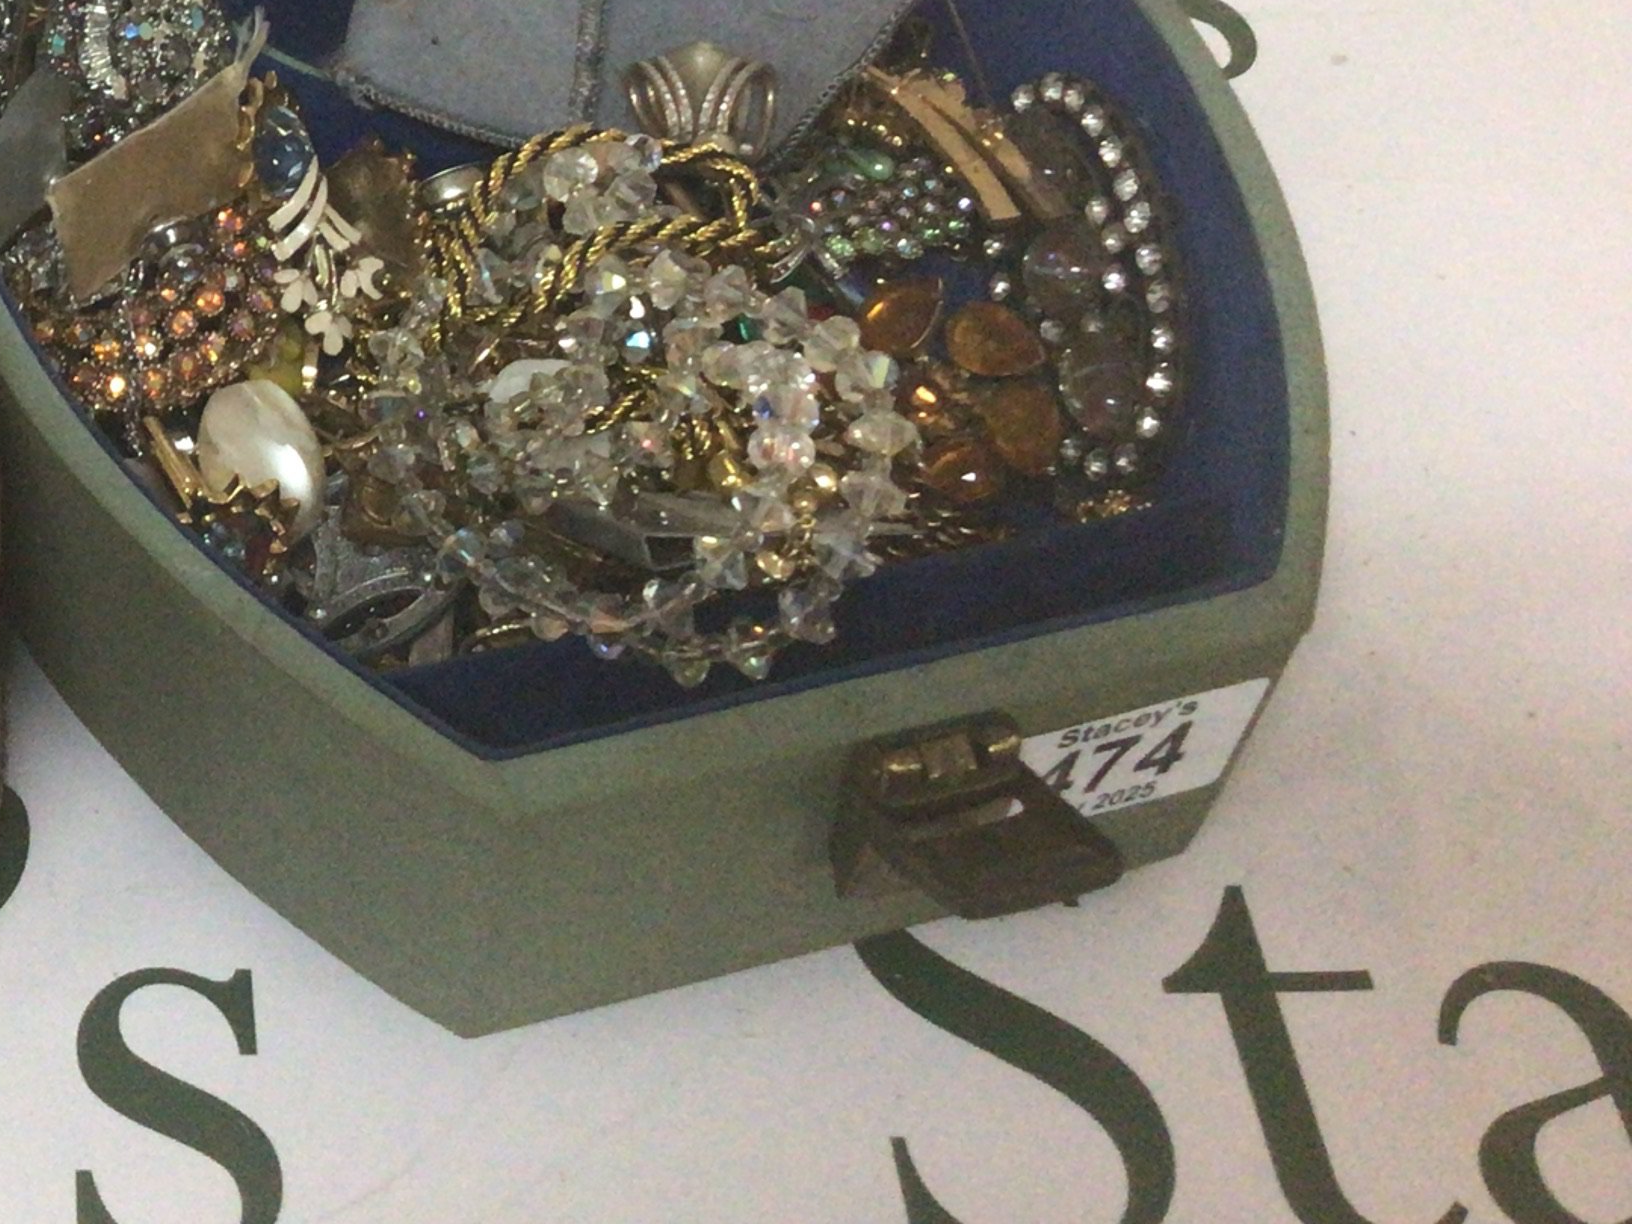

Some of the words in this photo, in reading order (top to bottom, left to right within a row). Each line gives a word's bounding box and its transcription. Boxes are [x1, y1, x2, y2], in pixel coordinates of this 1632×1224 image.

[1057, 699, 1200, 749] Stacey's
[1042, 720, 1194, 794] 474
[1093, 781, 1157, 811] 2025
